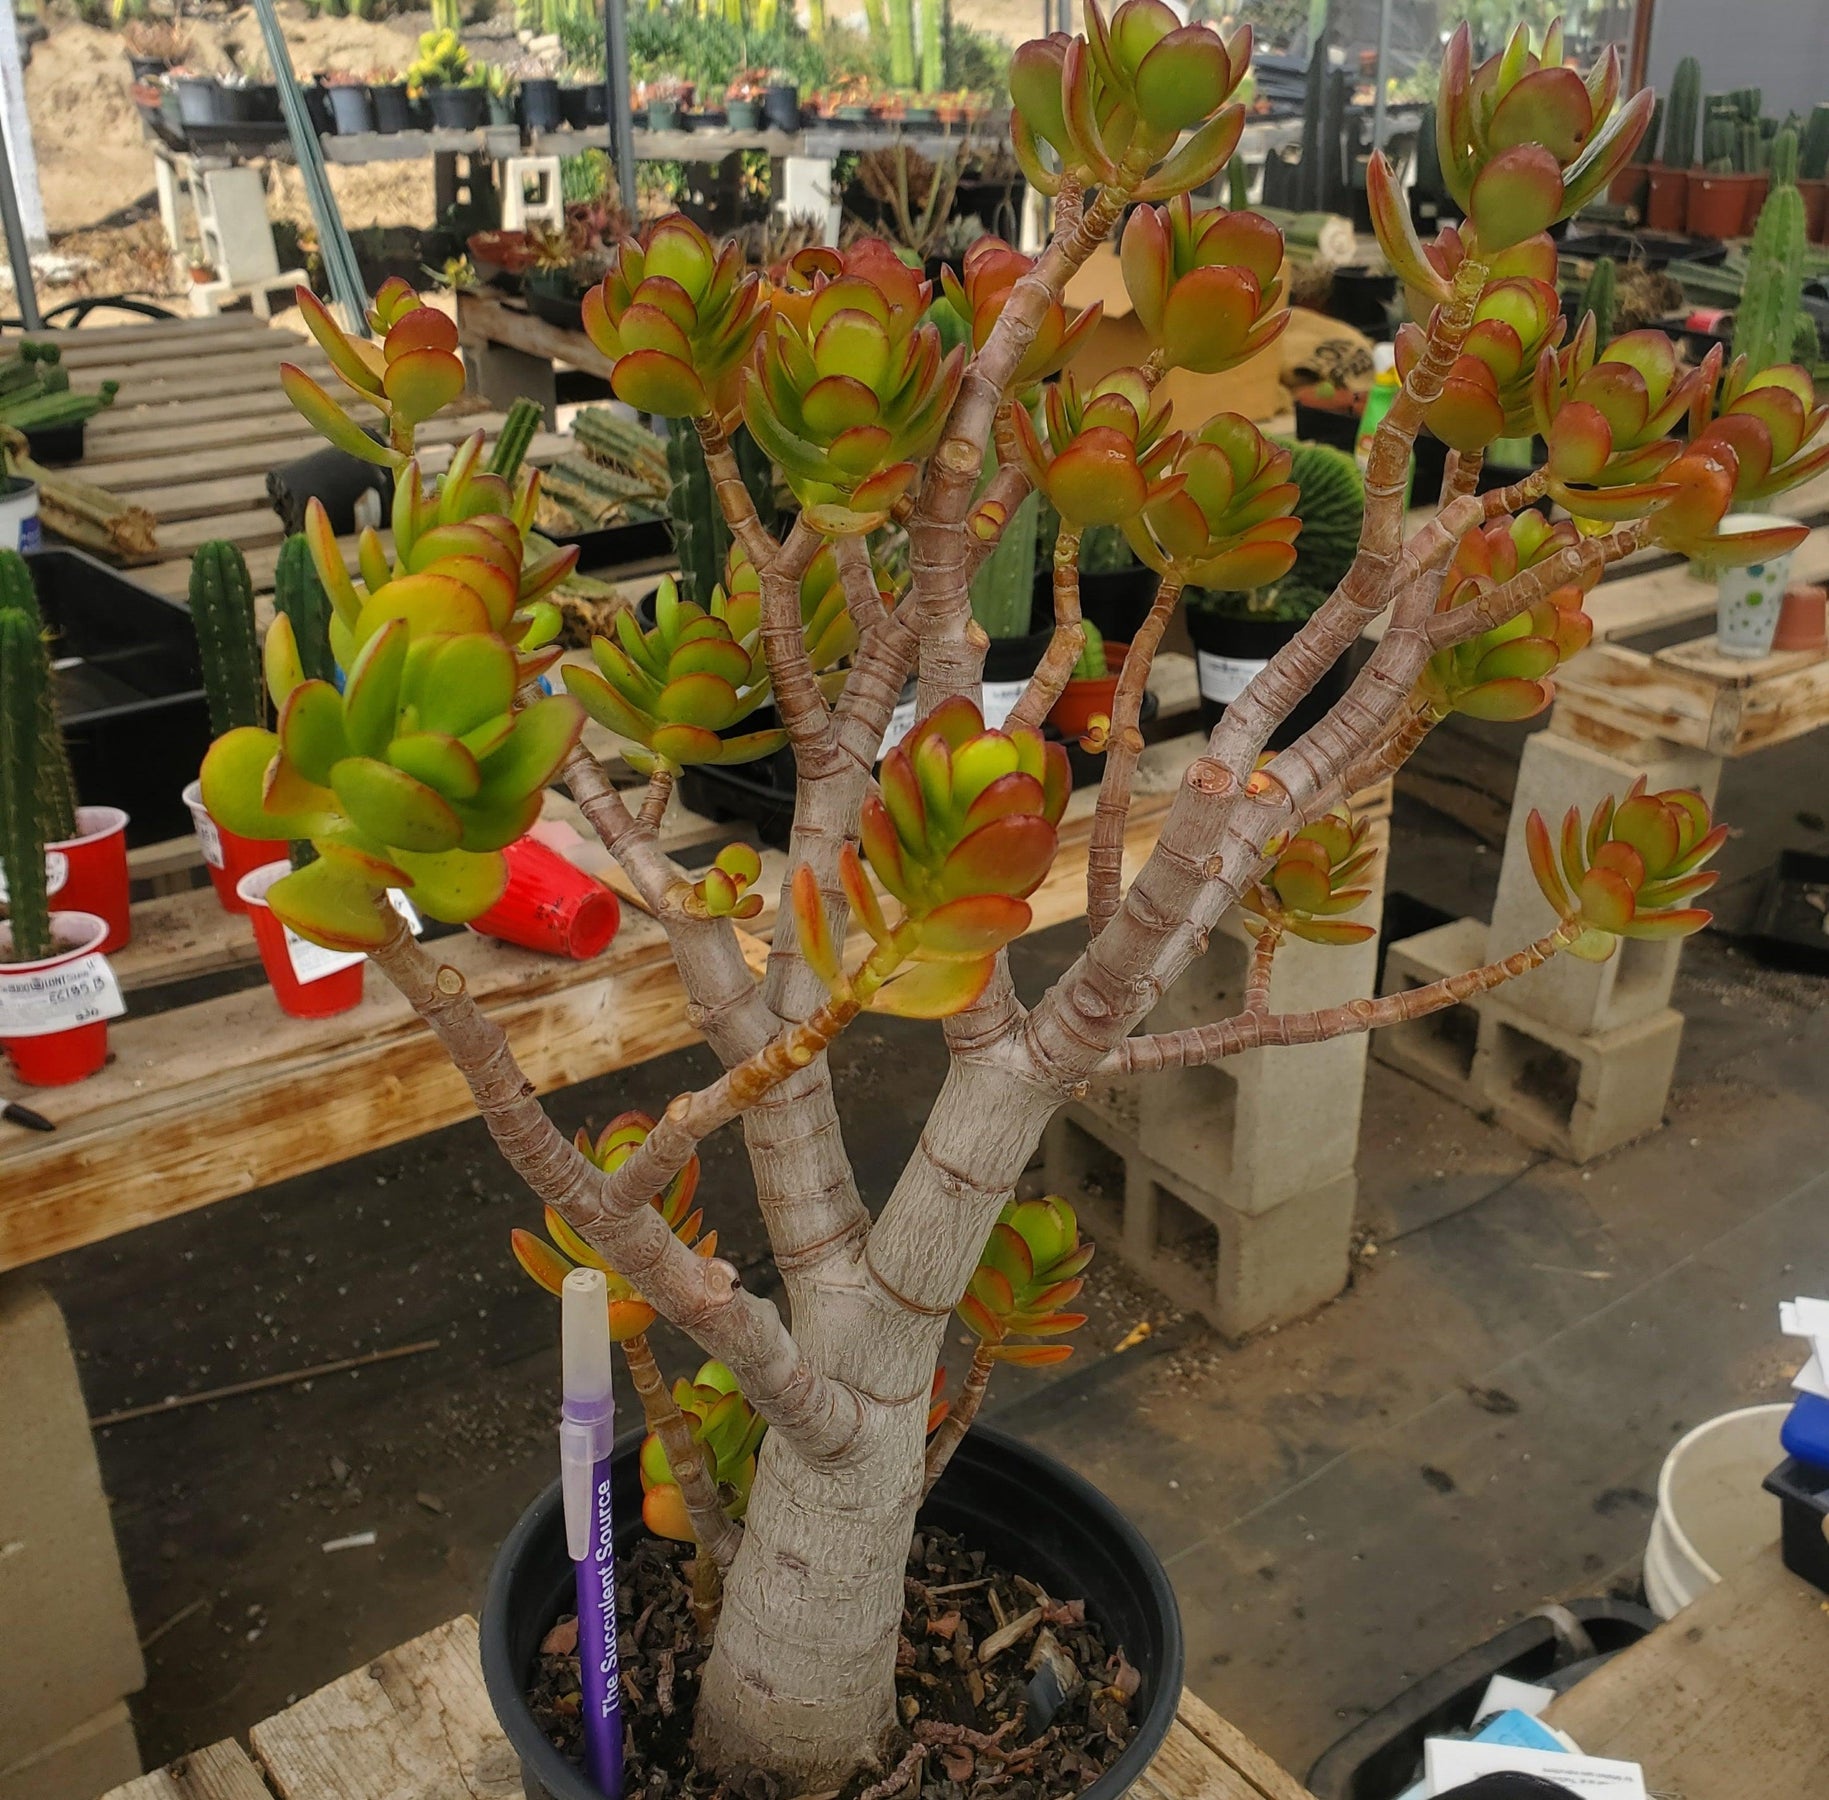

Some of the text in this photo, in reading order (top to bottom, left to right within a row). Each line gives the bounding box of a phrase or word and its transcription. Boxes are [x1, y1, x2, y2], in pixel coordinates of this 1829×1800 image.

[595, 1479, 619, 1718] The Succulent Source
